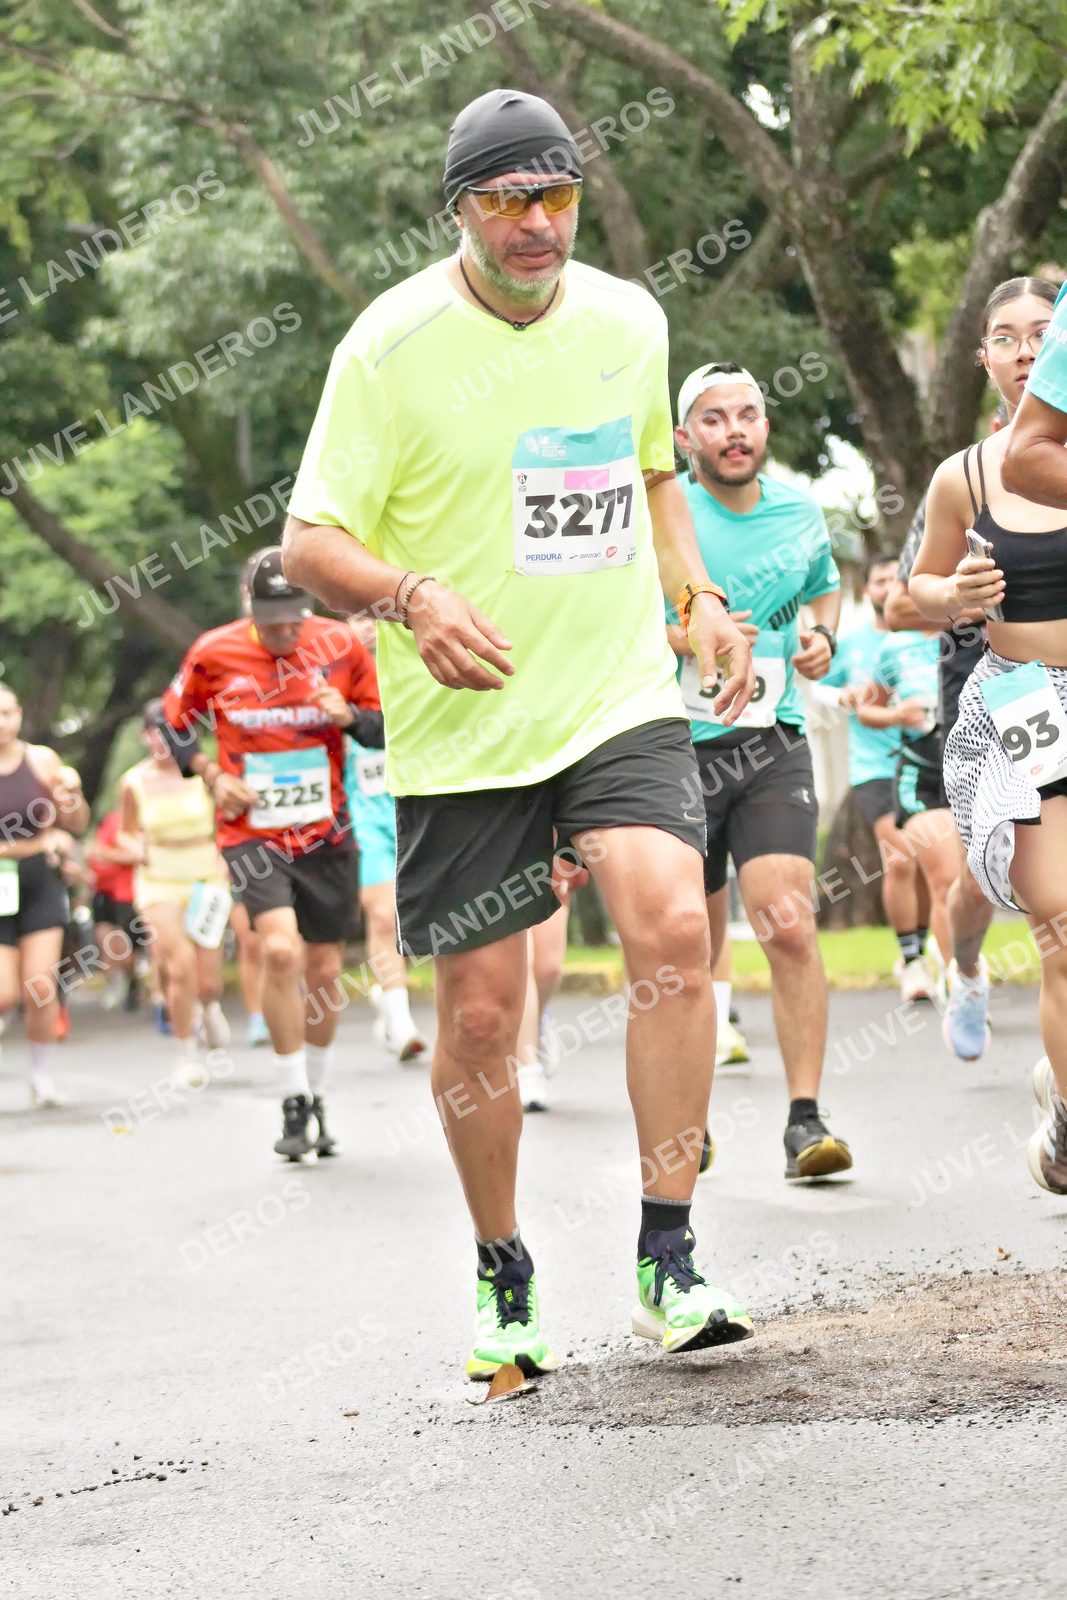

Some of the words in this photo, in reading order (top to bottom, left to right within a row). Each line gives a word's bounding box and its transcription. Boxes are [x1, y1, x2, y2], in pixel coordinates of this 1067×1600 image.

[524, 483, 633, 539] 3277
[526, 552, 563, 562] PERDURA
[1002, 709, 1060, 762] 93
